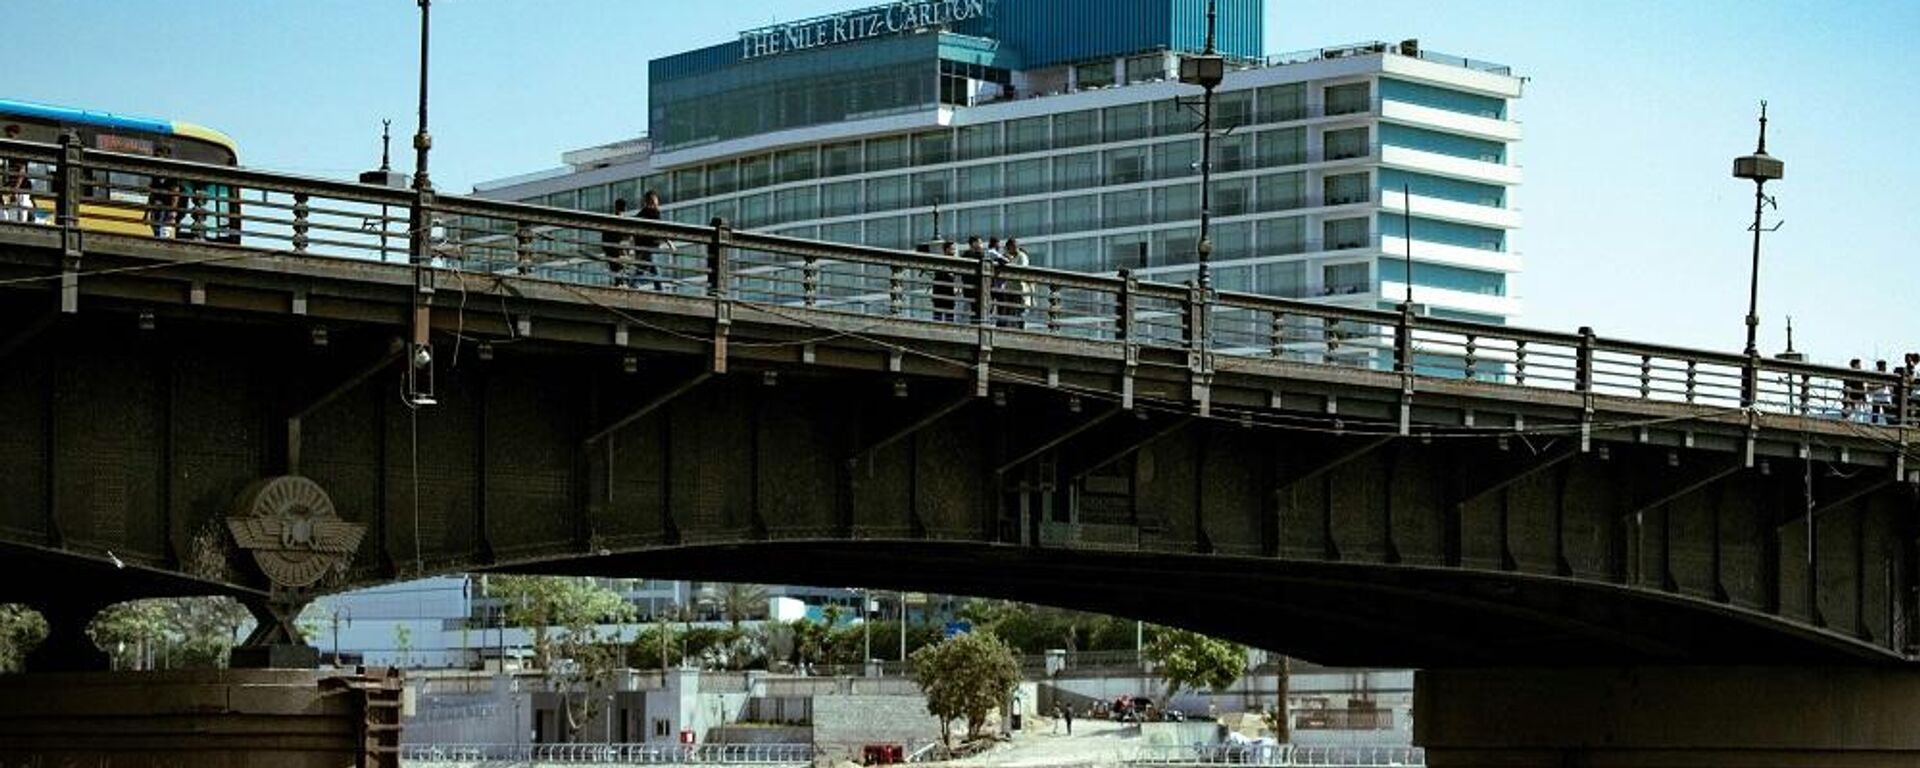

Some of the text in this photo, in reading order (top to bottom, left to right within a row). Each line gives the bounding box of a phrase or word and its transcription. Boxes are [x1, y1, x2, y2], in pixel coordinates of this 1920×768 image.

[742, 0, 984, 58] THE NILE RITZ-CARLTON
